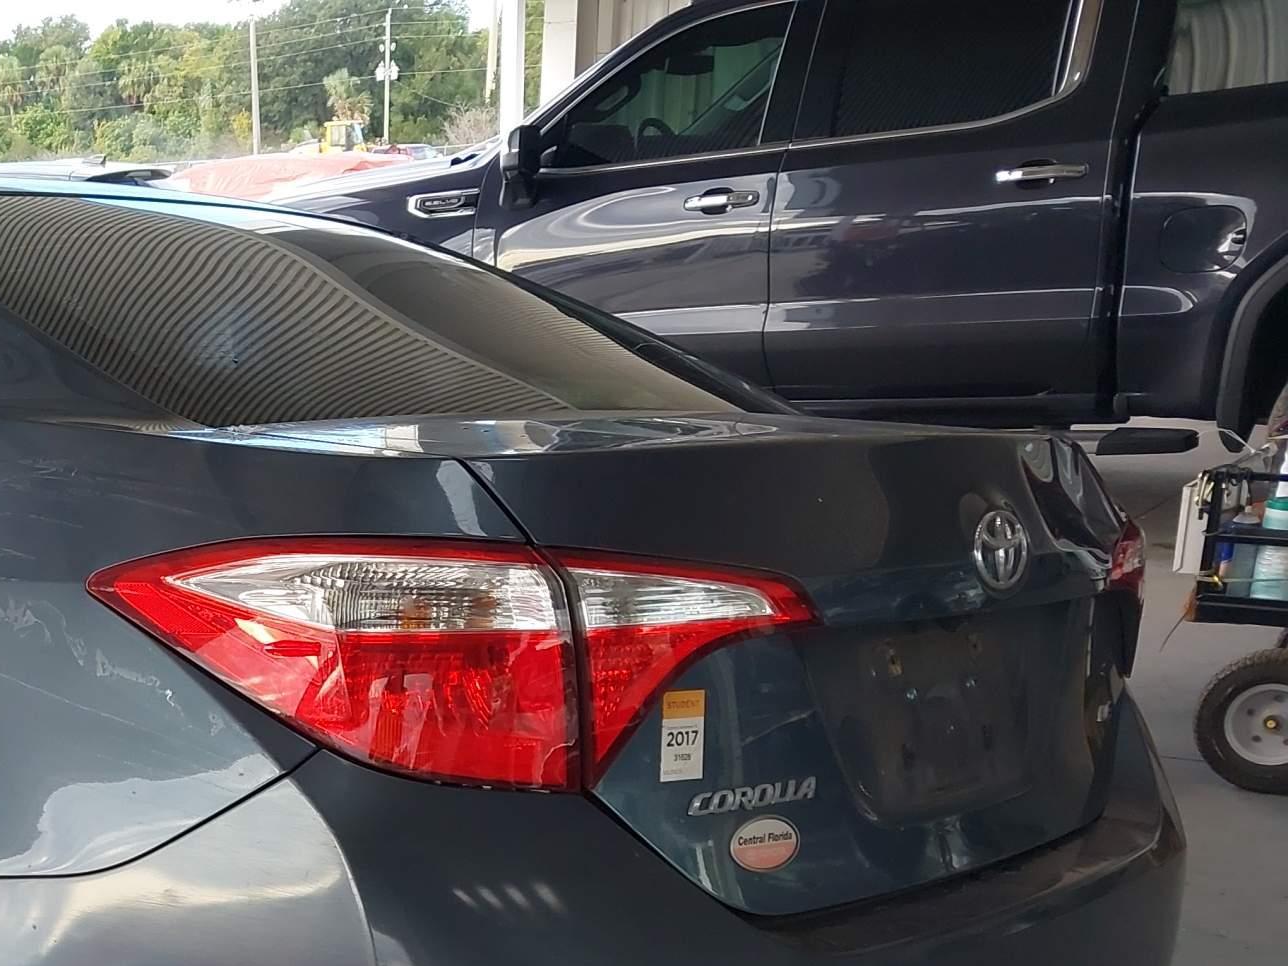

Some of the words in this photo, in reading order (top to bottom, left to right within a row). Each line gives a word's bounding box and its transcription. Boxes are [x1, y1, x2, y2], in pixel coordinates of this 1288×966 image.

[666, 730, 699, 748] 2017
[687, 775, 817, 817] COROLLA
[737, 833, 766, 847] Central
[767, 830, 793, 843] Florida
